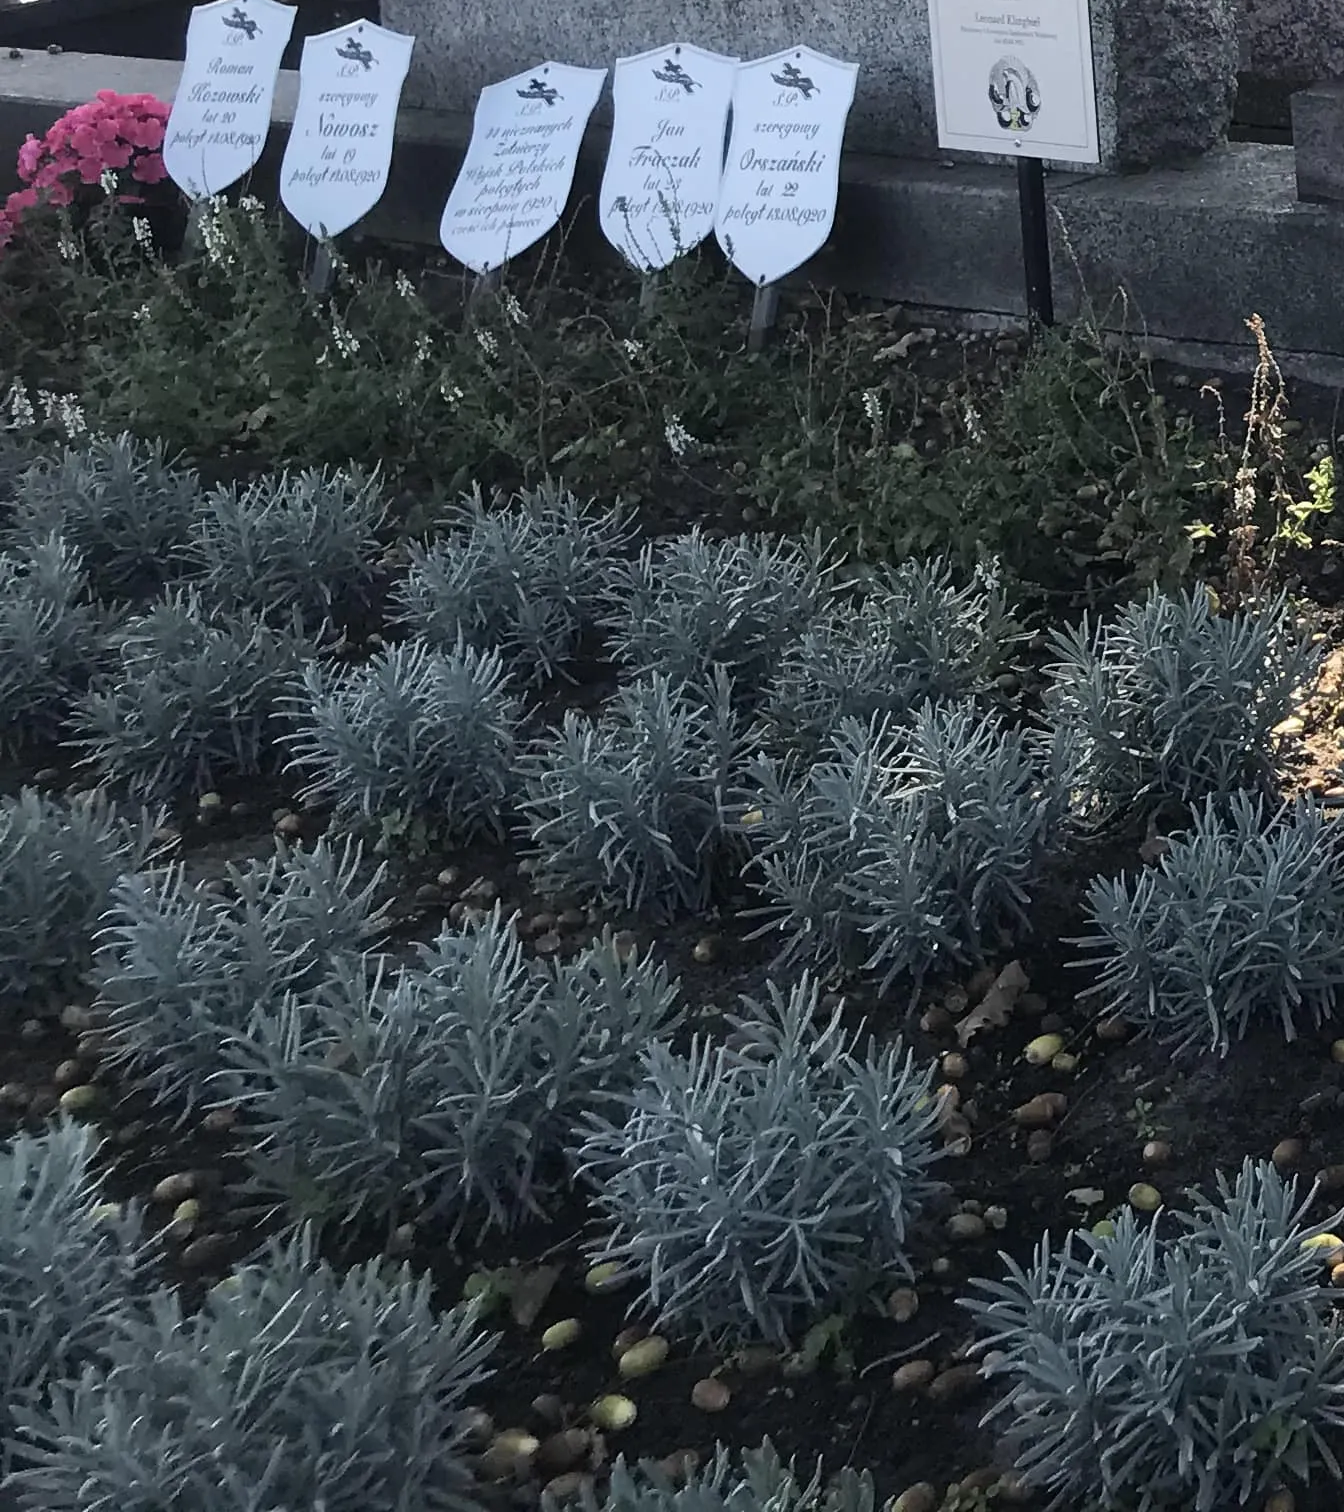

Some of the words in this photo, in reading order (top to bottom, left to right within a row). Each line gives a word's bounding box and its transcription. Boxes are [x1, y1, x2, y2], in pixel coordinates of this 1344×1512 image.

[206, 56, 254, 76] Roman
[202, 108, 219, 124] lat
[220, 111, 237, 124] 20
[501, 115, 574, 140] nieznanych
[651, 119, 685, 143] Jan
[321, 145, 338, 161] lat
[740, 147, 827, 174] Orszański
[507, 154, 567, 178] Polskich
[643, 173, 661, 191] lat
[756, 179, 775, 197] lat
[780, 181, 800, 198] 22
